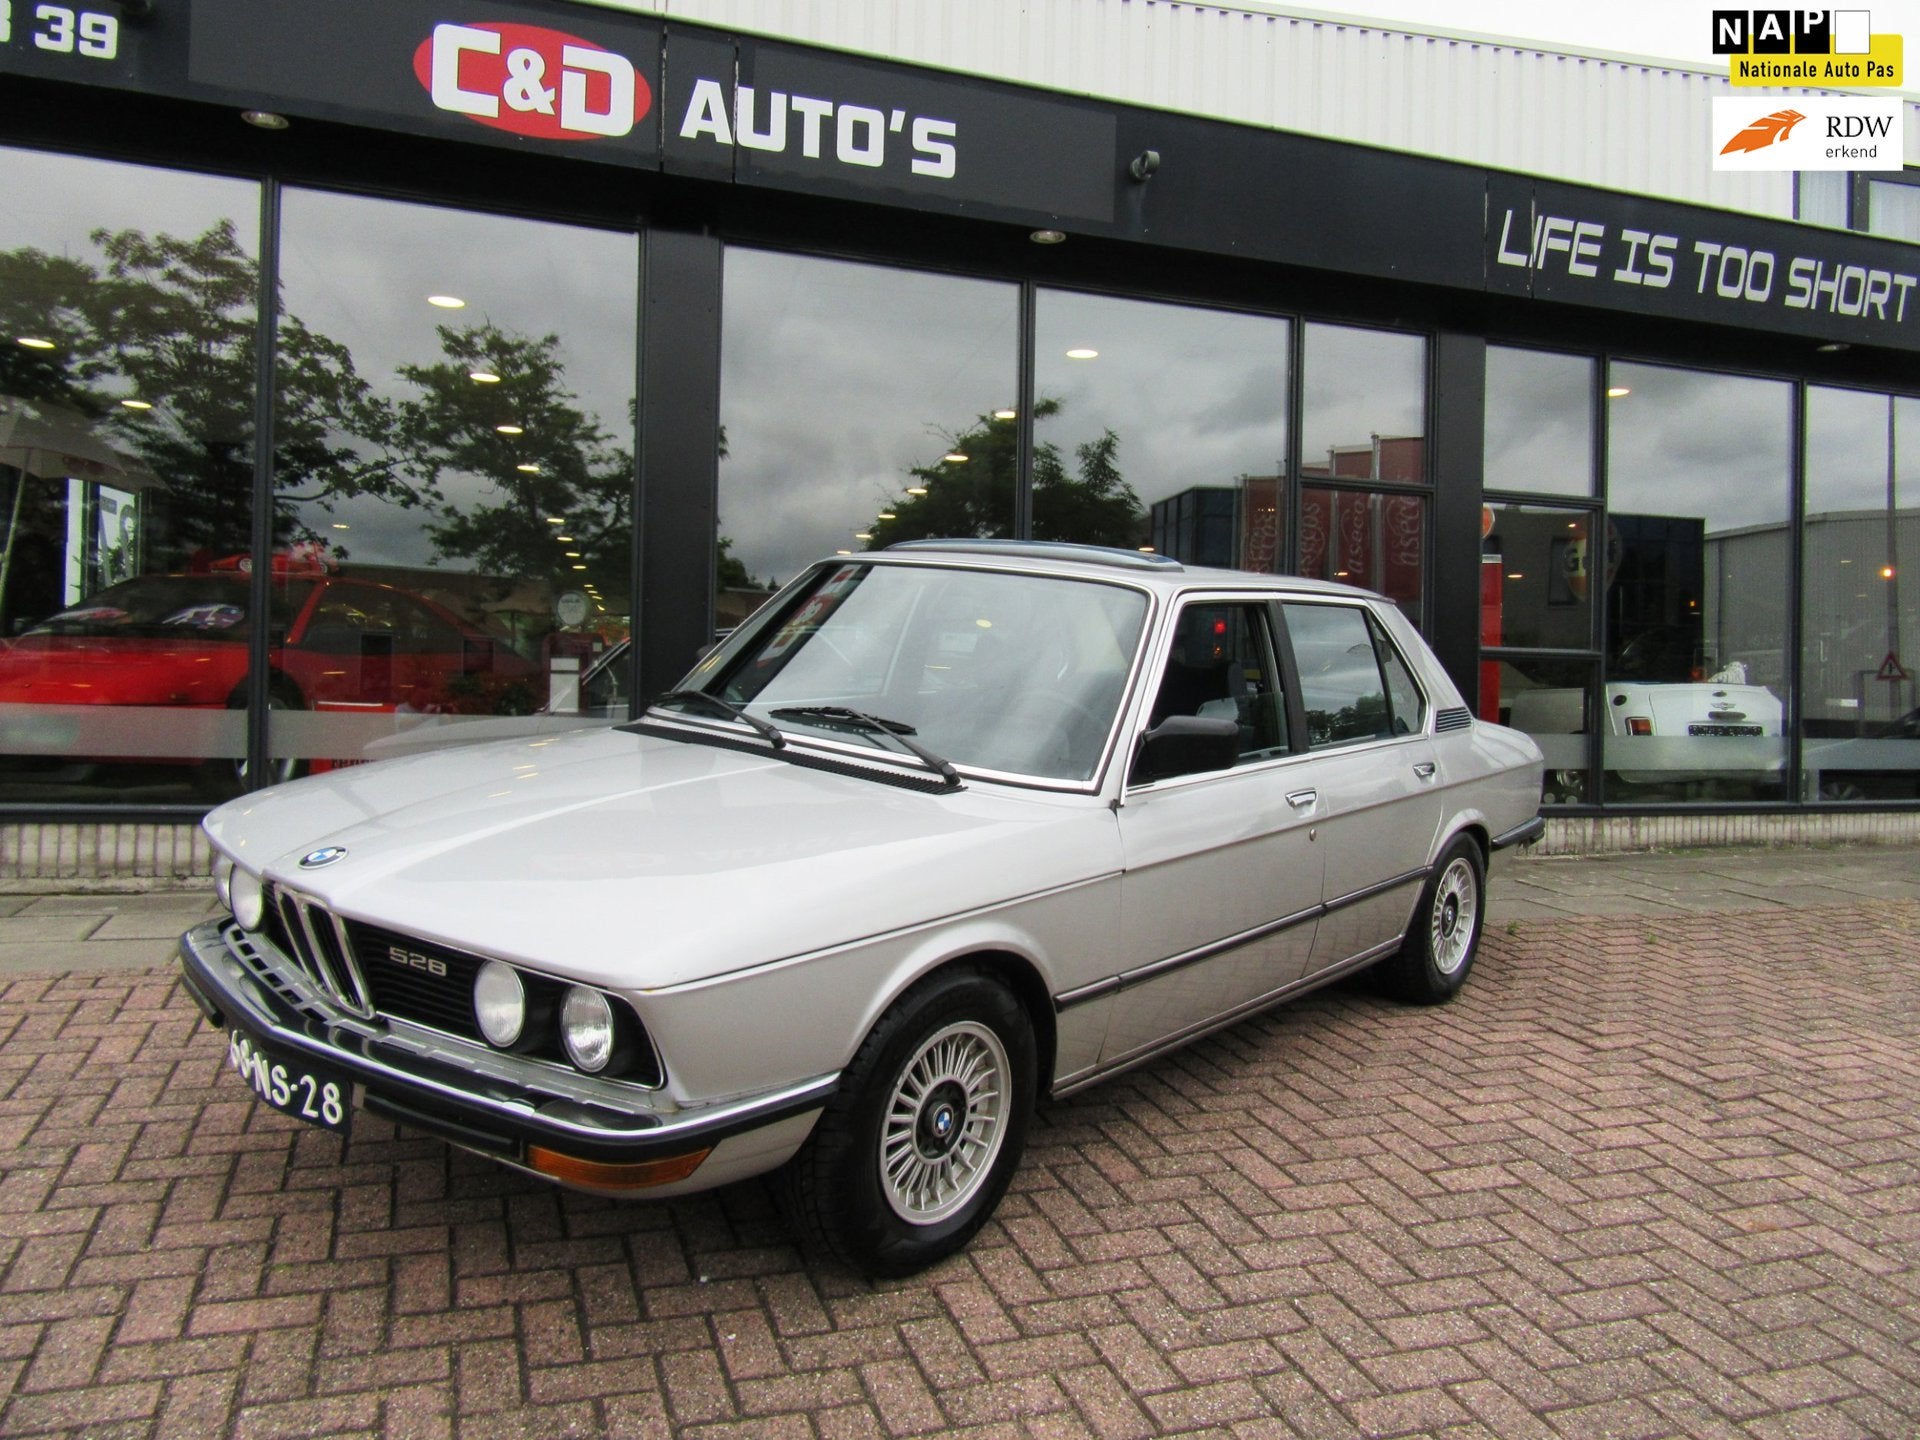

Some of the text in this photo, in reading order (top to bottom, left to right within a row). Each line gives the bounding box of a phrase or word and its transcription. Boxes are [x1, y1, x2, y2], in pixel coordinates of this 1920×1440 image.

[35, 4, 119, 59] 39
[431, 23, 957, 179] C&D AUTO'S
[1497, 209, 1918, 324] LIFE IS TOO SHORT
[389, 946, 447, 977] 528
